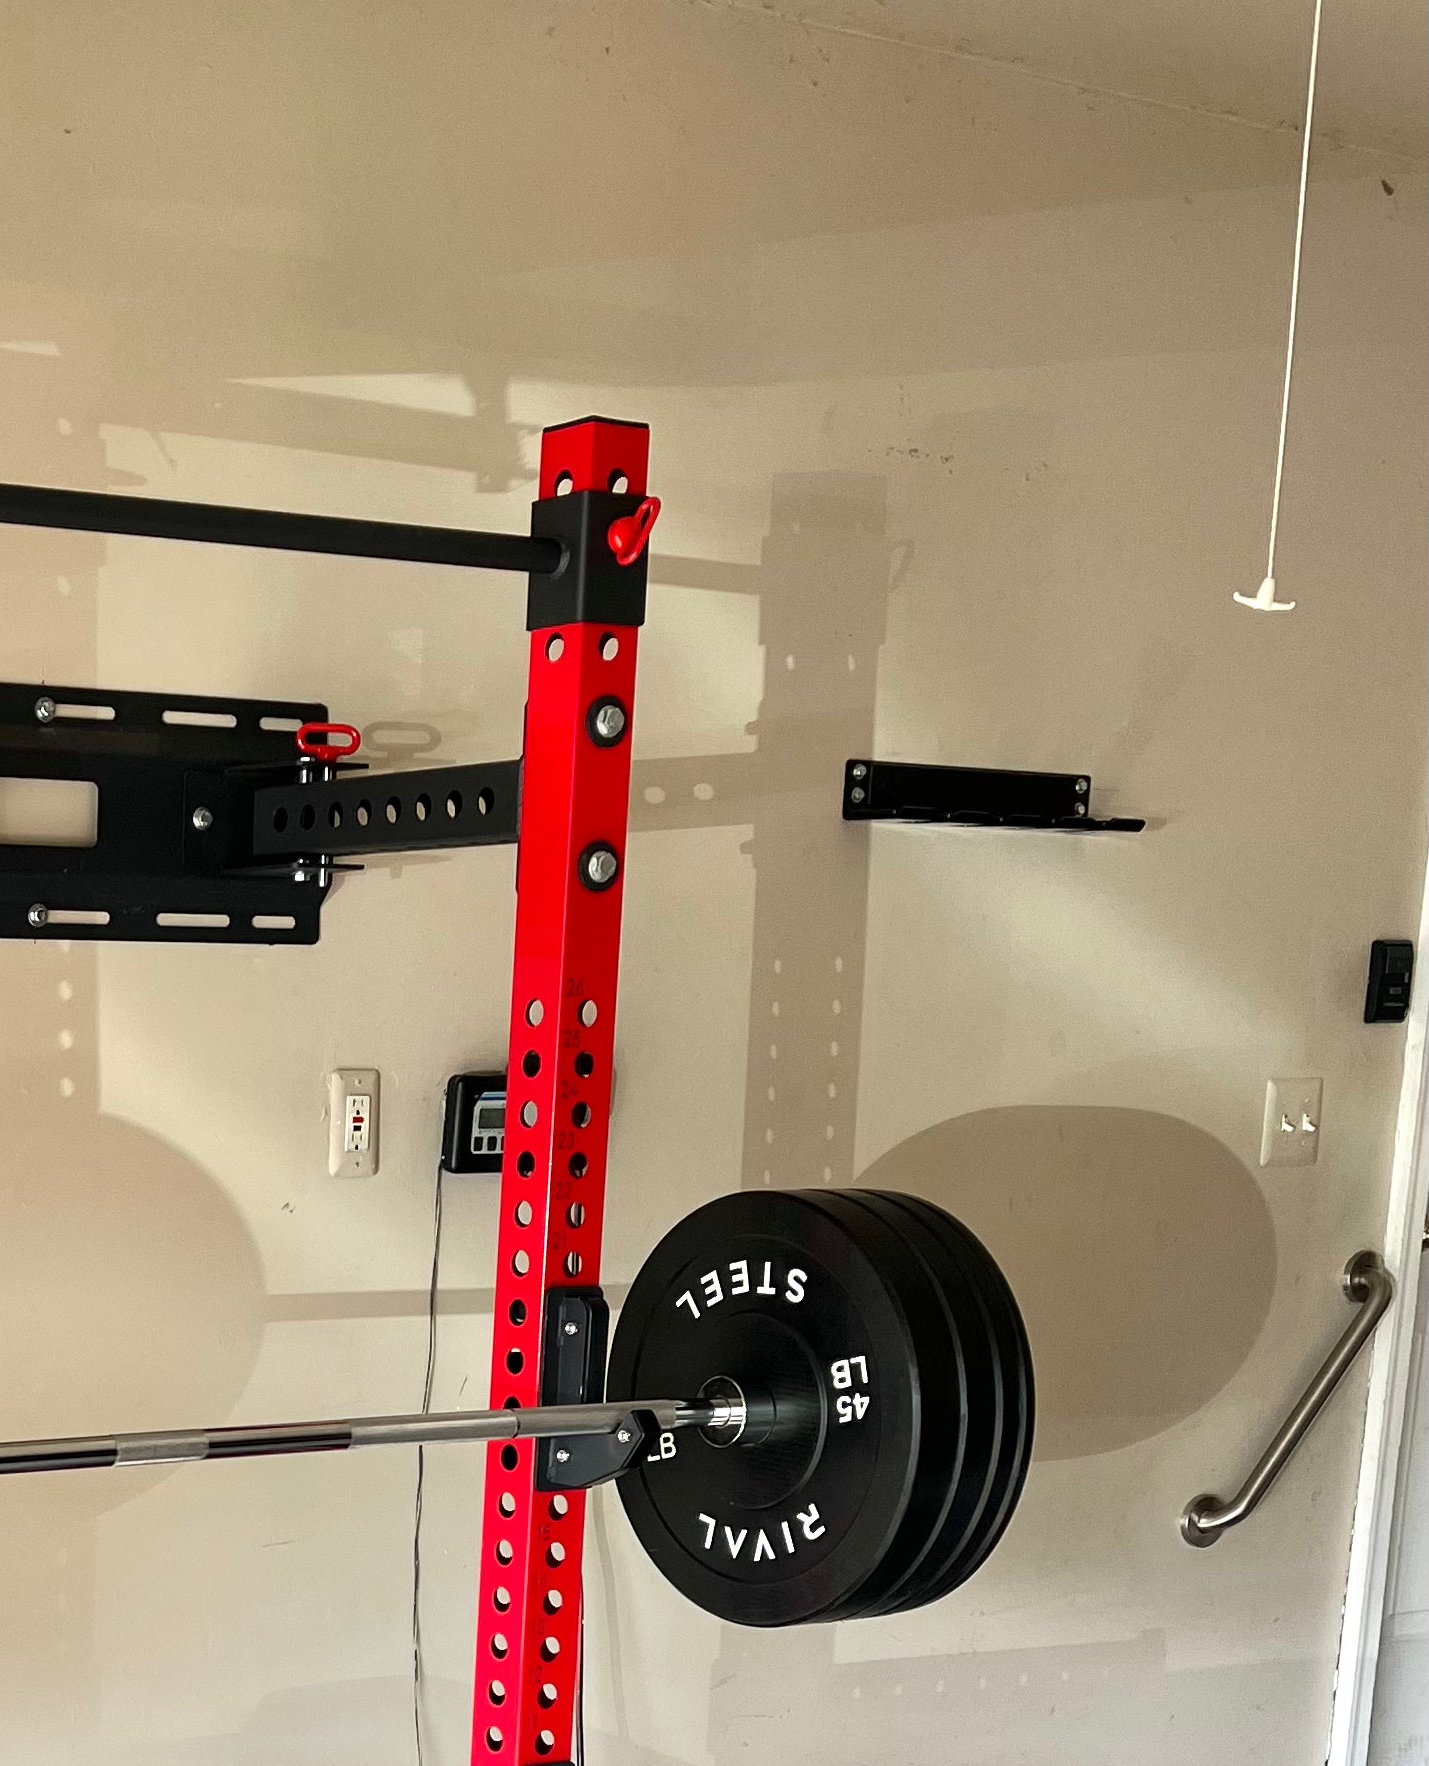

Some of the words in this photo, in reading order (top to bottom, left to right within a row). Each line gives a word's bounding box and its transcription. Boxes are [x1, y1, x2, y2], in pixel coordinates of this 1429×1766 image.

[676, 1259, 808, 1319] STEEL
[830, 1355, 869, 1389] LB
[836, 1394, 870, 1424] 45
[698, 1503, 826, 1562] RIVAL
